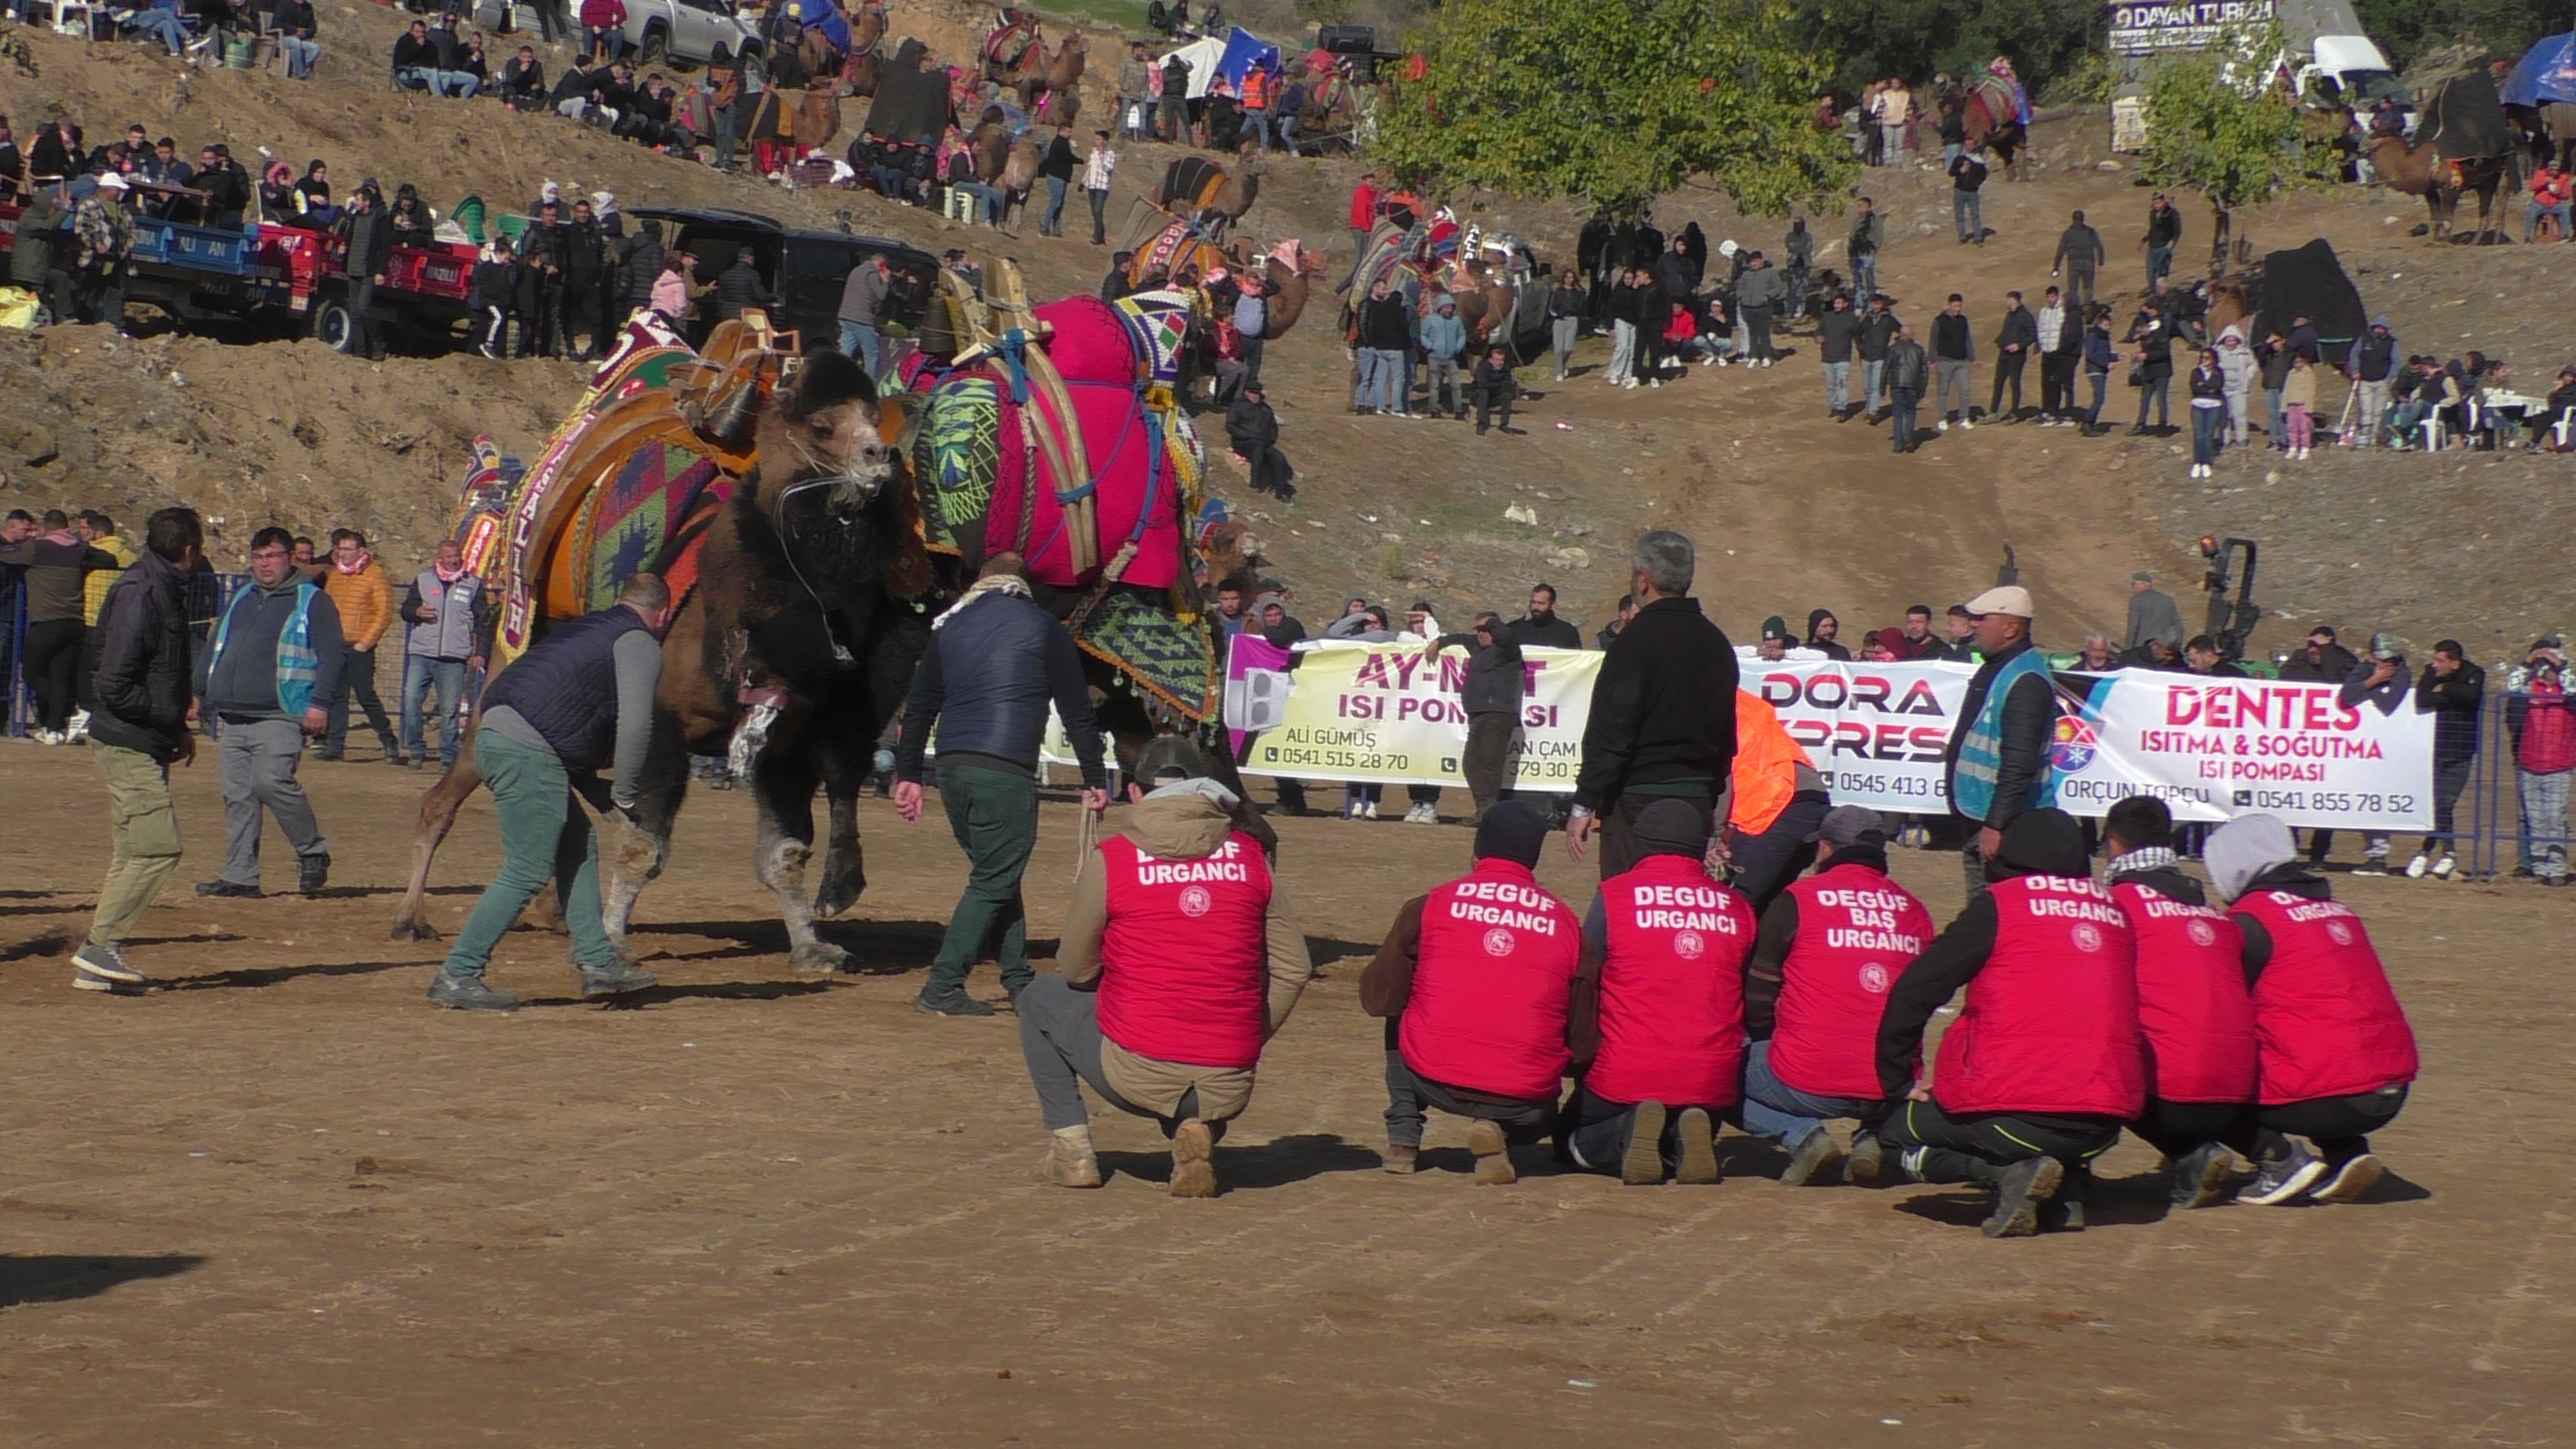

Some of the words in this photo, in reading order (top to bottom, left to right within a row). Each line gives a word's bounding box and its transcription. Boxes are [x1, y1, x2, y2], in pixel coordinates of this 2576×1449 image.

[2134, 4, 2196, 27] DAYAN
[1354, 653, 1547, 697] AY-MT
[1761, 673, 1945, 716] DORA
[1338, 694, 1384, 719] ISI
[1398, 697, 1558, 727] POMSI
[2166, 685, 2361, 731] DENTES
[1286, 726, 1309, 744] ALİ
[1315, 727, 1377, 751] GÜMÜŞ
[1508, 740, 1533, 755] AN
[1539, 741, 1576, 760] ÇAM
[1778, 719, 1950, 763] PRES
[2141, 730, 2226, 756] ISITMA
[2233, 734, 2250, 756] &
[2257, 731, 2382, 759] SOĞUTMA
[1283, 748, 1321, 765] 0541
[1325, 751, 1355, 767] 515
[1360, 753, 1381, 769] 28
[1387, 754, 1408, 770] 70
[1509, 761, 1540, 776] 379
[1546, 762, 1568, 778] 30
[1573, 763, 1582, 778] 3
[2199, 760, 2225, 778] ISI
[2232, 761, 2325, 782] POMPASI
[1841, 772, 1885, 793] 0545
[1892, 777, 1928, 796] 413
[1934, 779, 1947, 797] 6
[2065, 779, 2136, 804] ORÇUN
[2142, 783, 2209, 808] TOPÇU
[2257, 790, 2306, 809] 0541
[2312, 792, 2350, 811] 855
[2356, 794, 2381, 813] 78
[2388, 795, 2414, 813] 52
[1138, 863, 1247, 886] URGANCI
[1456, 882, 1555, 912] DEGÜF
[1634, 886, 1730, 910] DEGÜF
[1817, 889, 1909, 912] DEGÜF
[1450, 902, 1556, 936] URGANCI
[1636, 910, 1737, 935] URGANCI
[1850, 907, 1896, 932] BAŞ
[2029, 899, 2125, 928] URGANCI
[2144, 901, 2231, 922] URGA
[2286, 901, 2356, 922] URGA
[1828, 928, 1920, 955] URGANCI
